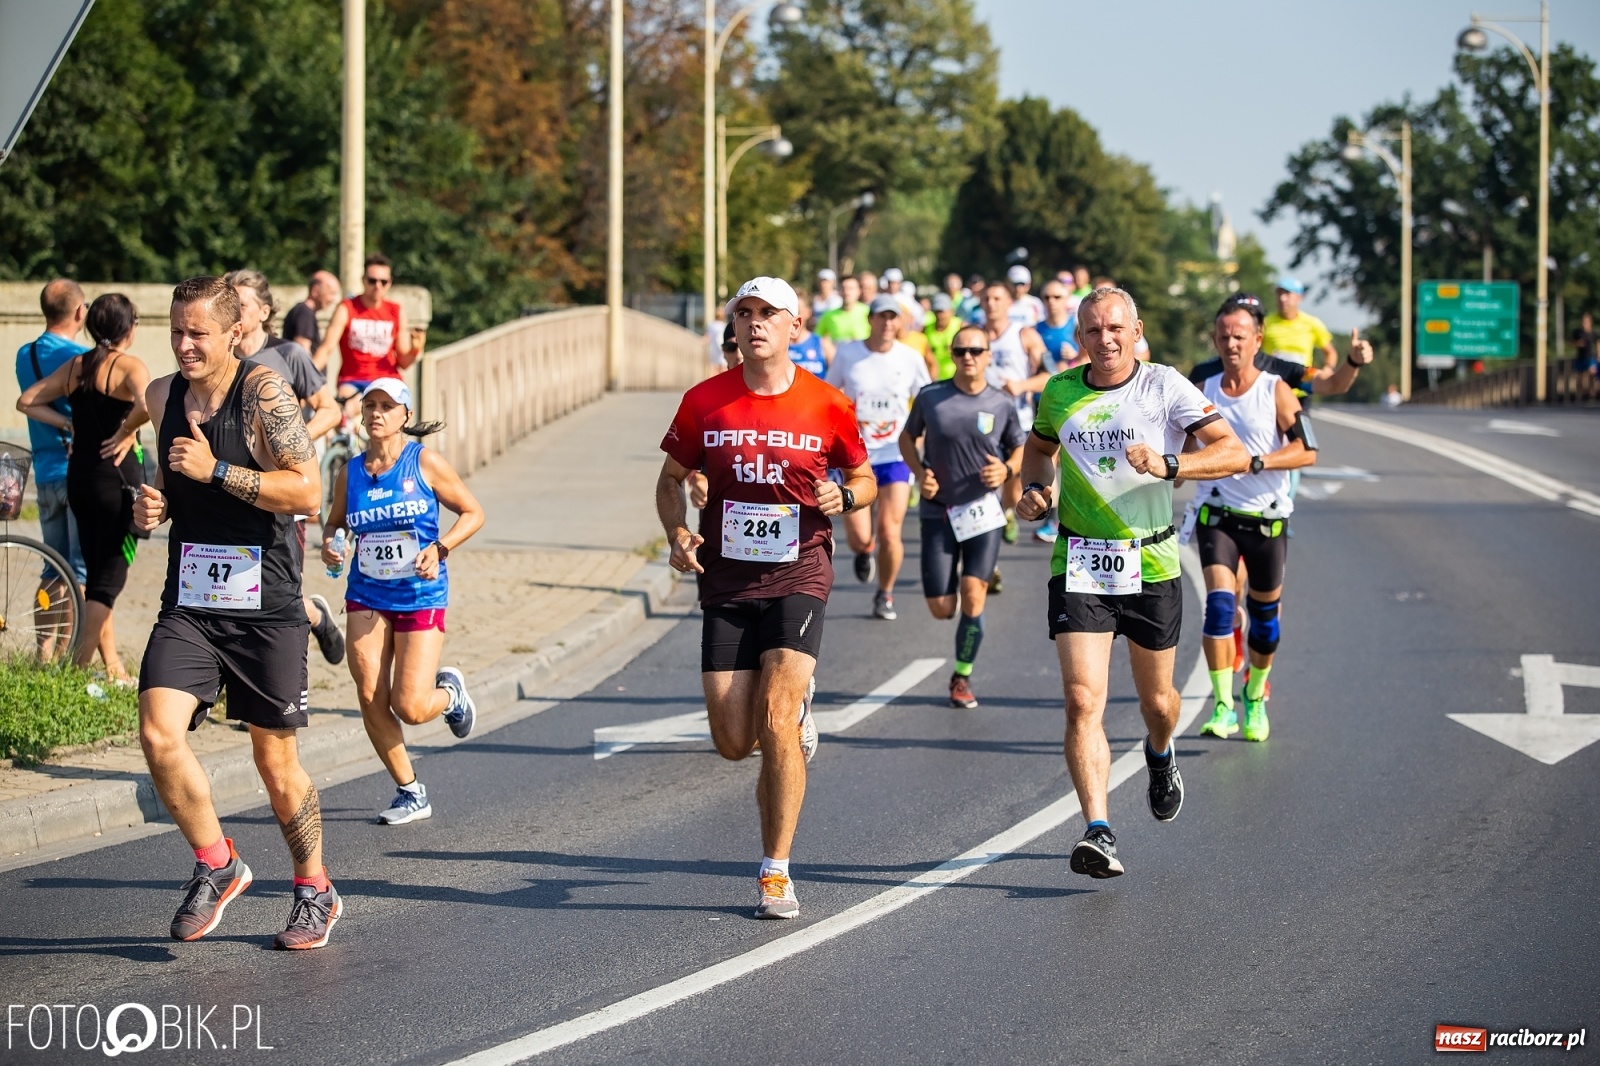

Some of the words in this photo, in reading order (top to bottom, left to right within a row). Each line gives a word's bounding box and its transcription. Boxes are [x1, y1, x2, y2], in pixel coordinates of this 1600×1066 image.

[704, 430, 822, 452] DAR-BUD
[1068, 428, 1135, 444] AKTYWNI
[1082, 443, 1122, 451] LYSKI
[969, 505, 984, 519] 93
[393, 518, 415, 526] TEAM
[743, 519, 781, 539] 284
[374, 544, 403, 560] 281
[1091, 553, 1125, 573] 300
[207, 562, 232, 583] 47
